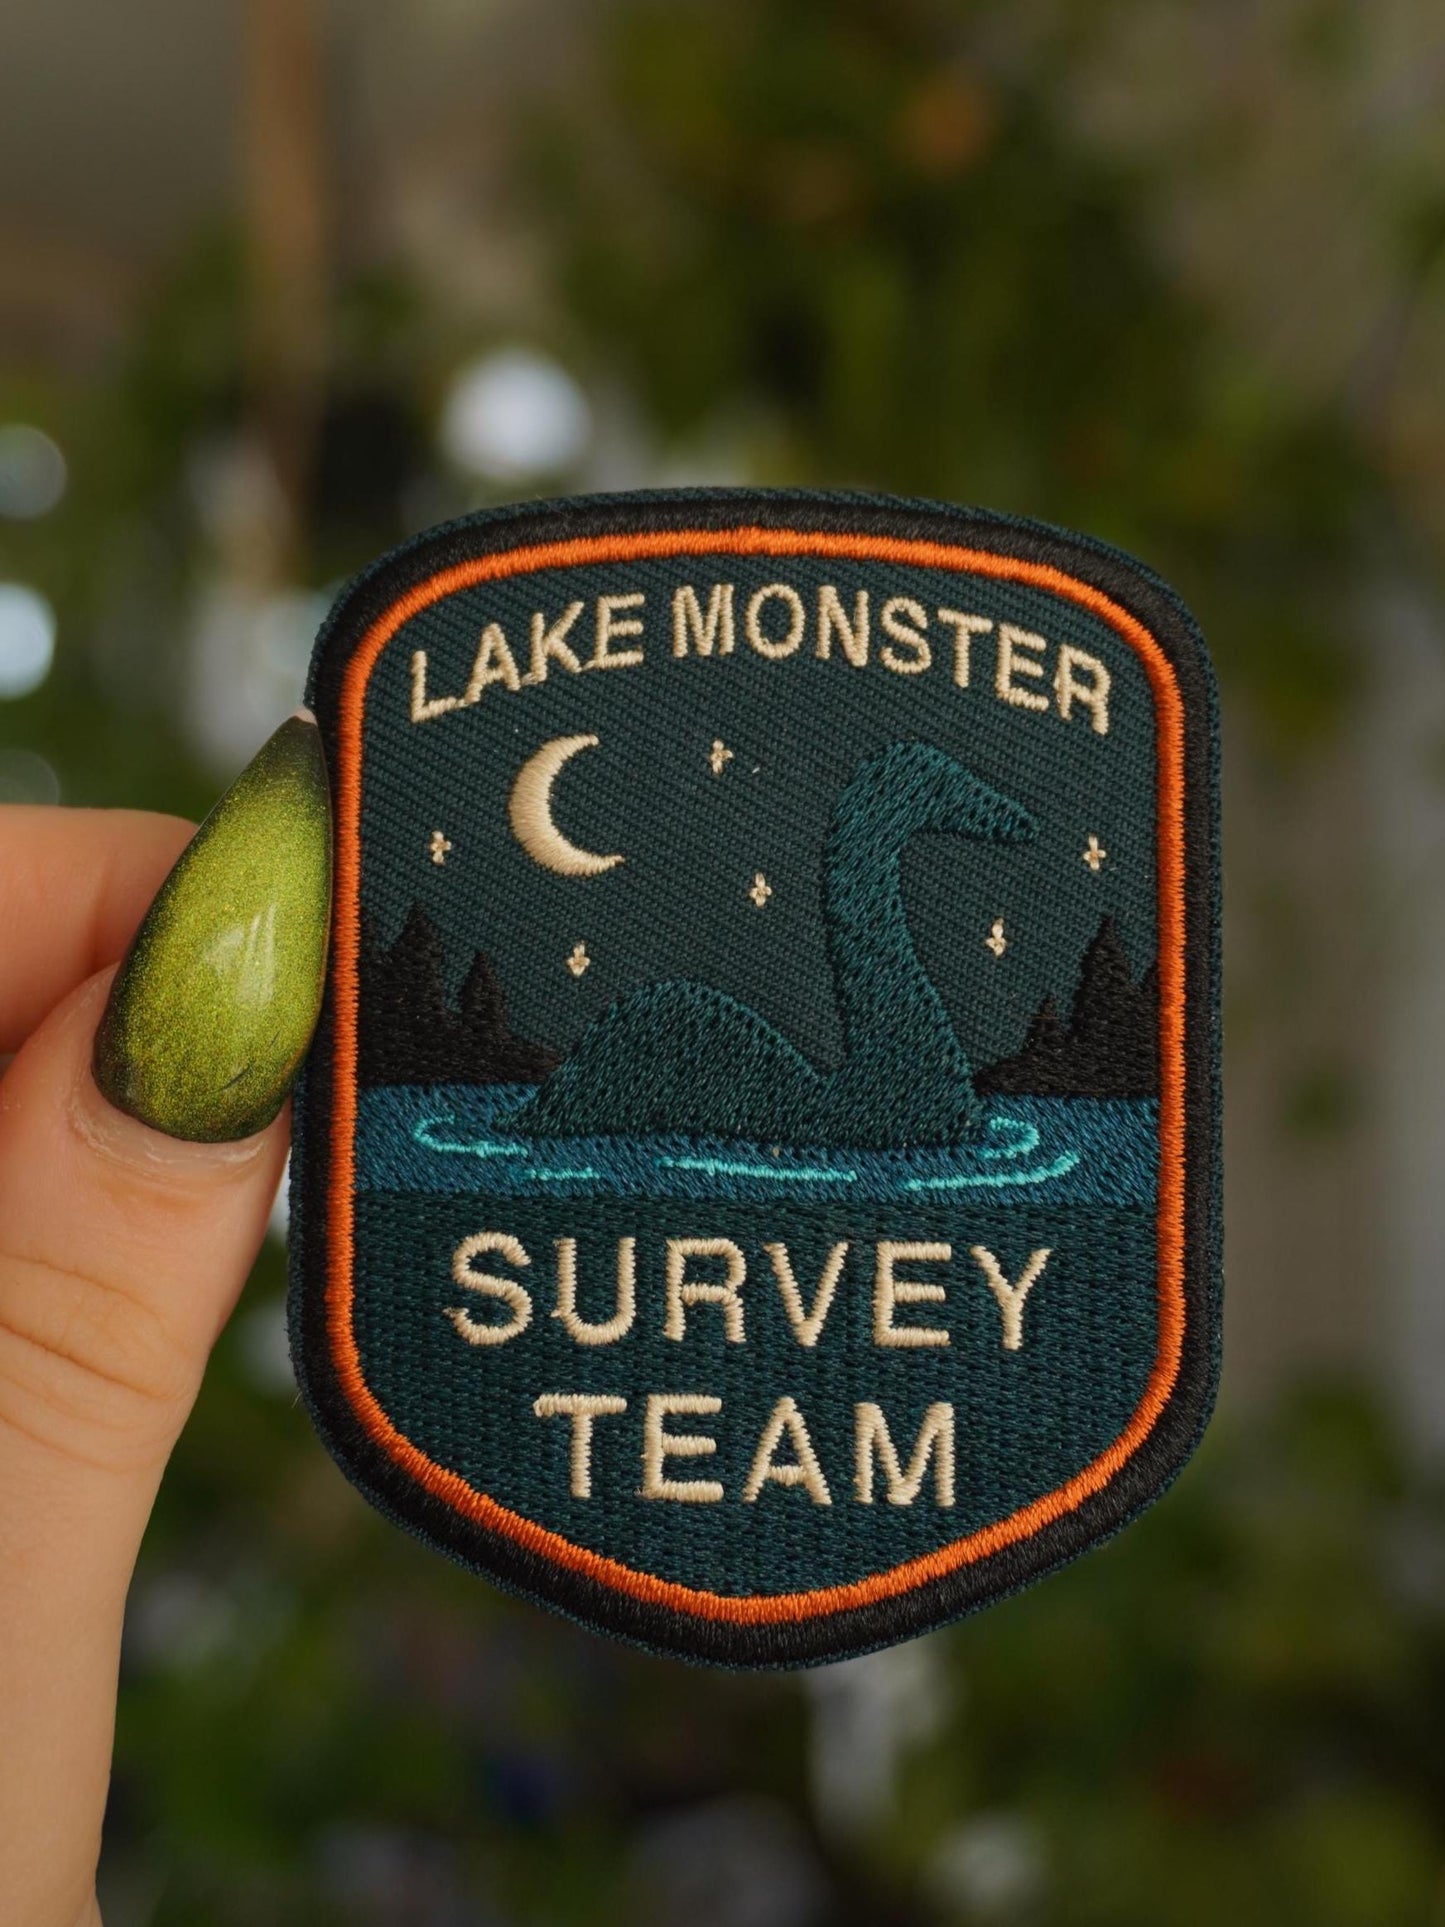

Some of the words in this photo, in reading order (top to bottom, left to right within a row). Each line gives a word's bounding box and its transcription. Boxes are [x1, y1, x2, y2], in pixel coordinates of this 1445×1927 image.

[411, 593, 645, 722] LAKE
[671, 583, 1112, 735] MONSTER
[449, 1232, 1051, 1350] SURVEY
[532, 1392, 956, 1507] TEAM
